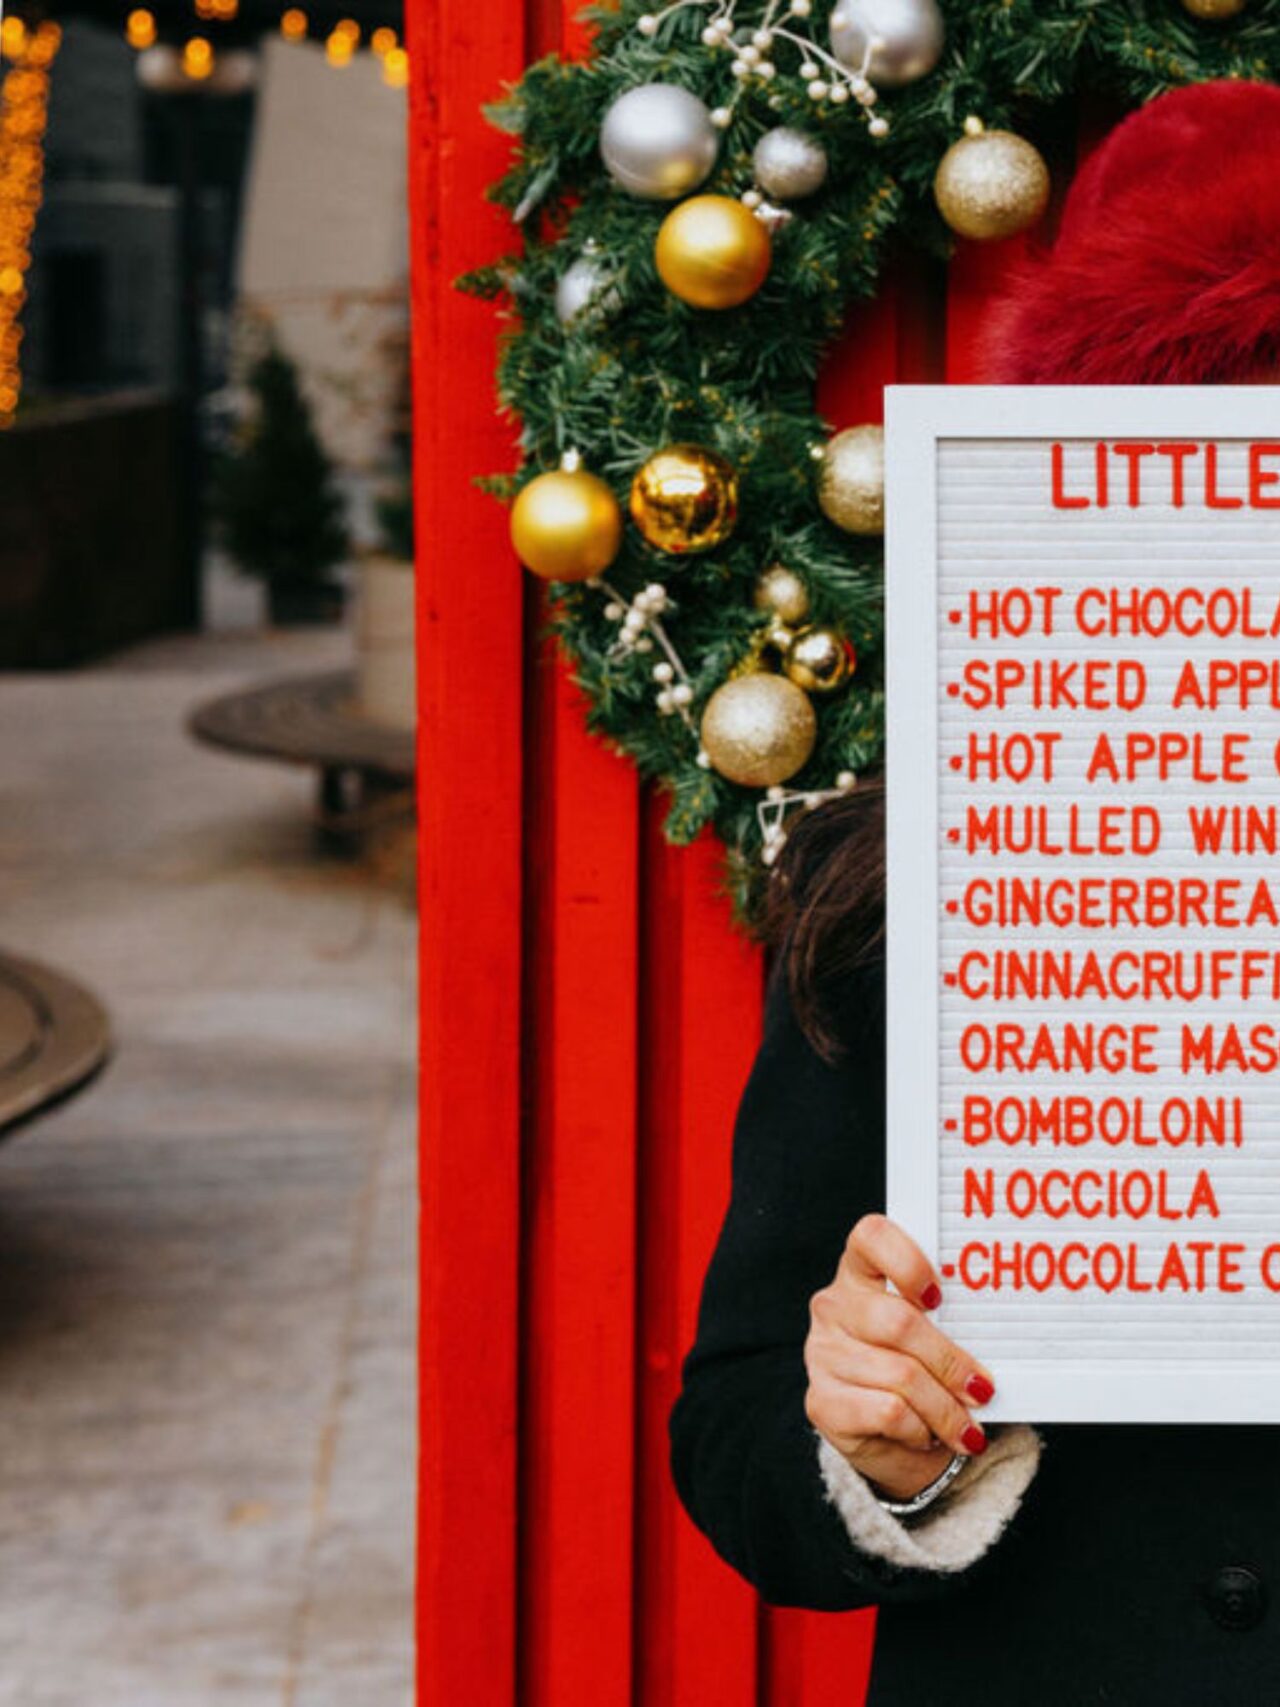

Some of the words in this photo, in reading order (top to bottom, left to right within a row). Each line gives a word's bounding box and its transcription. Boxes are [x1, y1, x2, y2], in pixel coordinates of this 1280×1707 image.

[968, 586, 1063, 640] HOT
[962, 658, 1147, 712] SPIKED
[967, 731, 1063, 784] HOT
[1086, 731, 1251, 784] APPLE
[966, 803, 1162, 857] MULLED
[959, 1022, 1159, 1075] ORANGE
[962, 1094, 1243, 1148] BOMBOLONI
[963, 1167, 1220, 1221] NOCCIOLA
[957, 1241, 1246, 1294] CHOCOLATE
